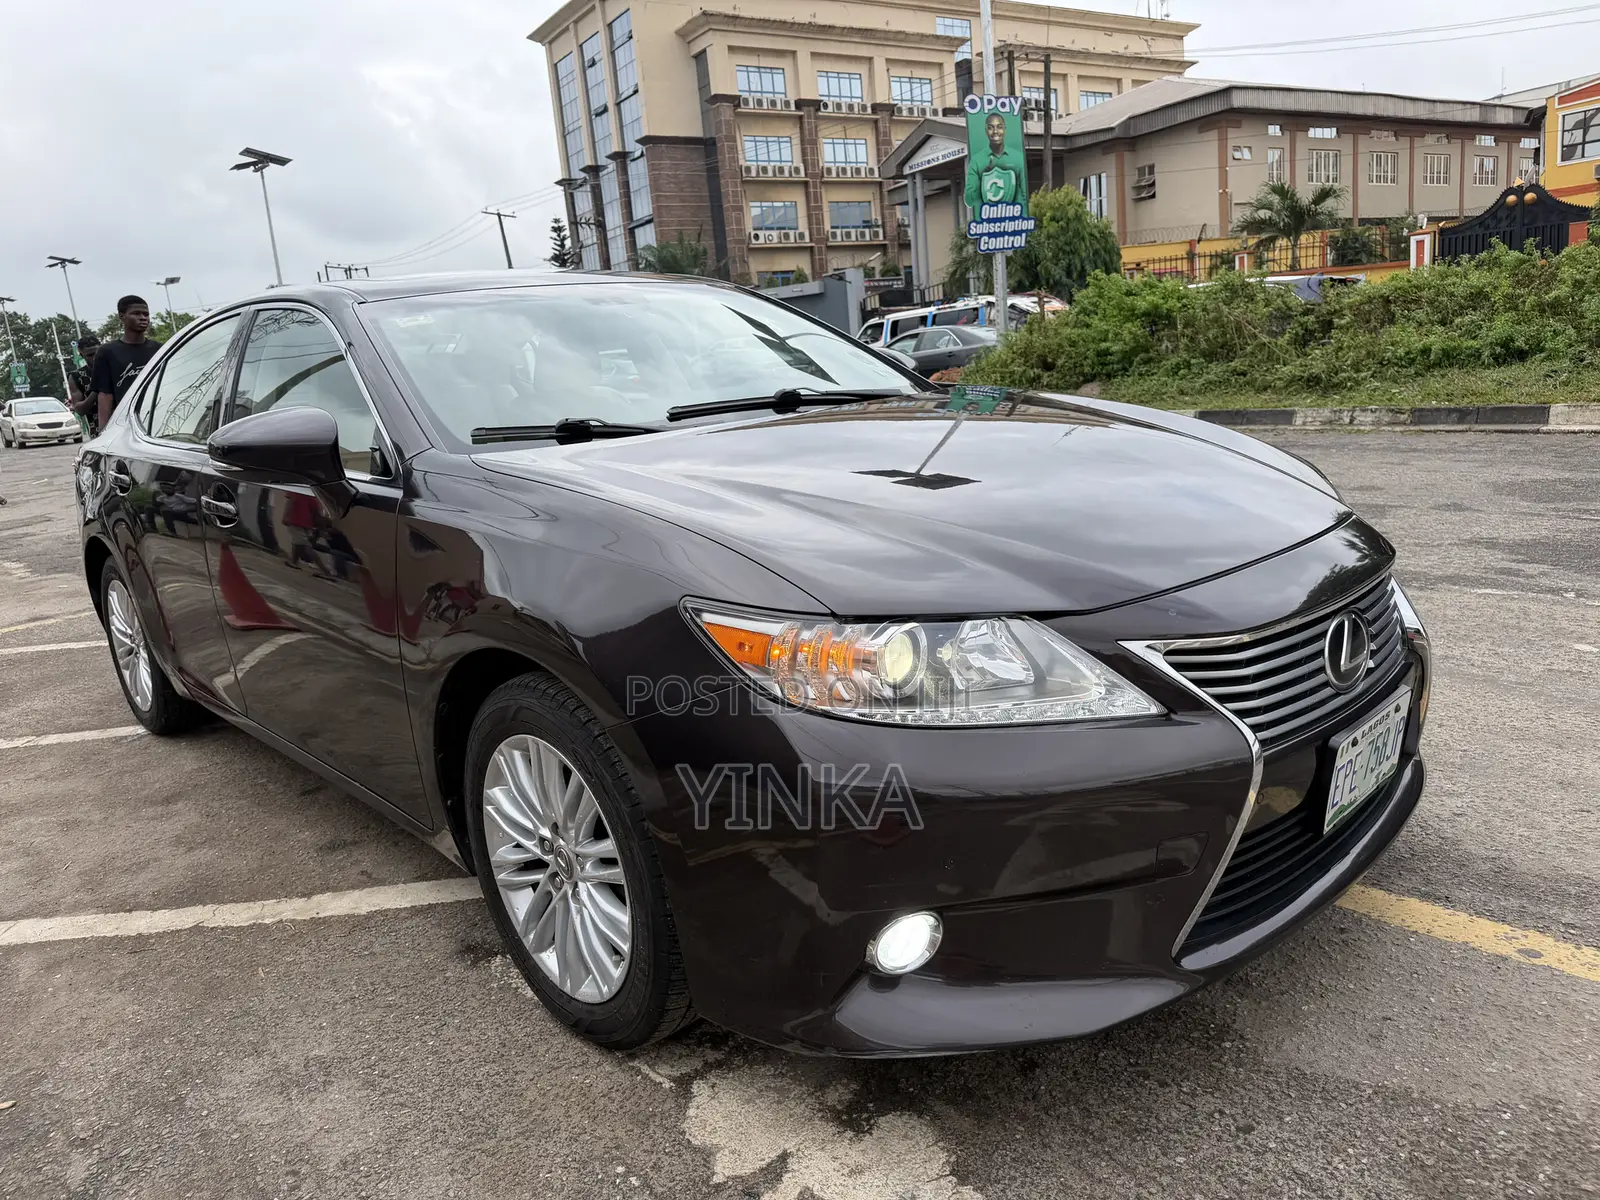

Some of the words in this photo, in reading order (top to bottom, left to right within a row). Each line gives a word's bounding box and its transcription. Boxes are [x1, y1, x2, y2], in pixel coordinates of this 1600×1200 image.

[964, 94, 1022, 116] OPay
[908, 155, 940, 171] MISSIONS
[941, 147, 965, 160] HOUSE
[981, 204, 1021, 220] Online
[969, 218, 1035, 235] Subscription
[980, 233, 1026, 251] Control
[1361, 710, 1390, 739] LAGOS
